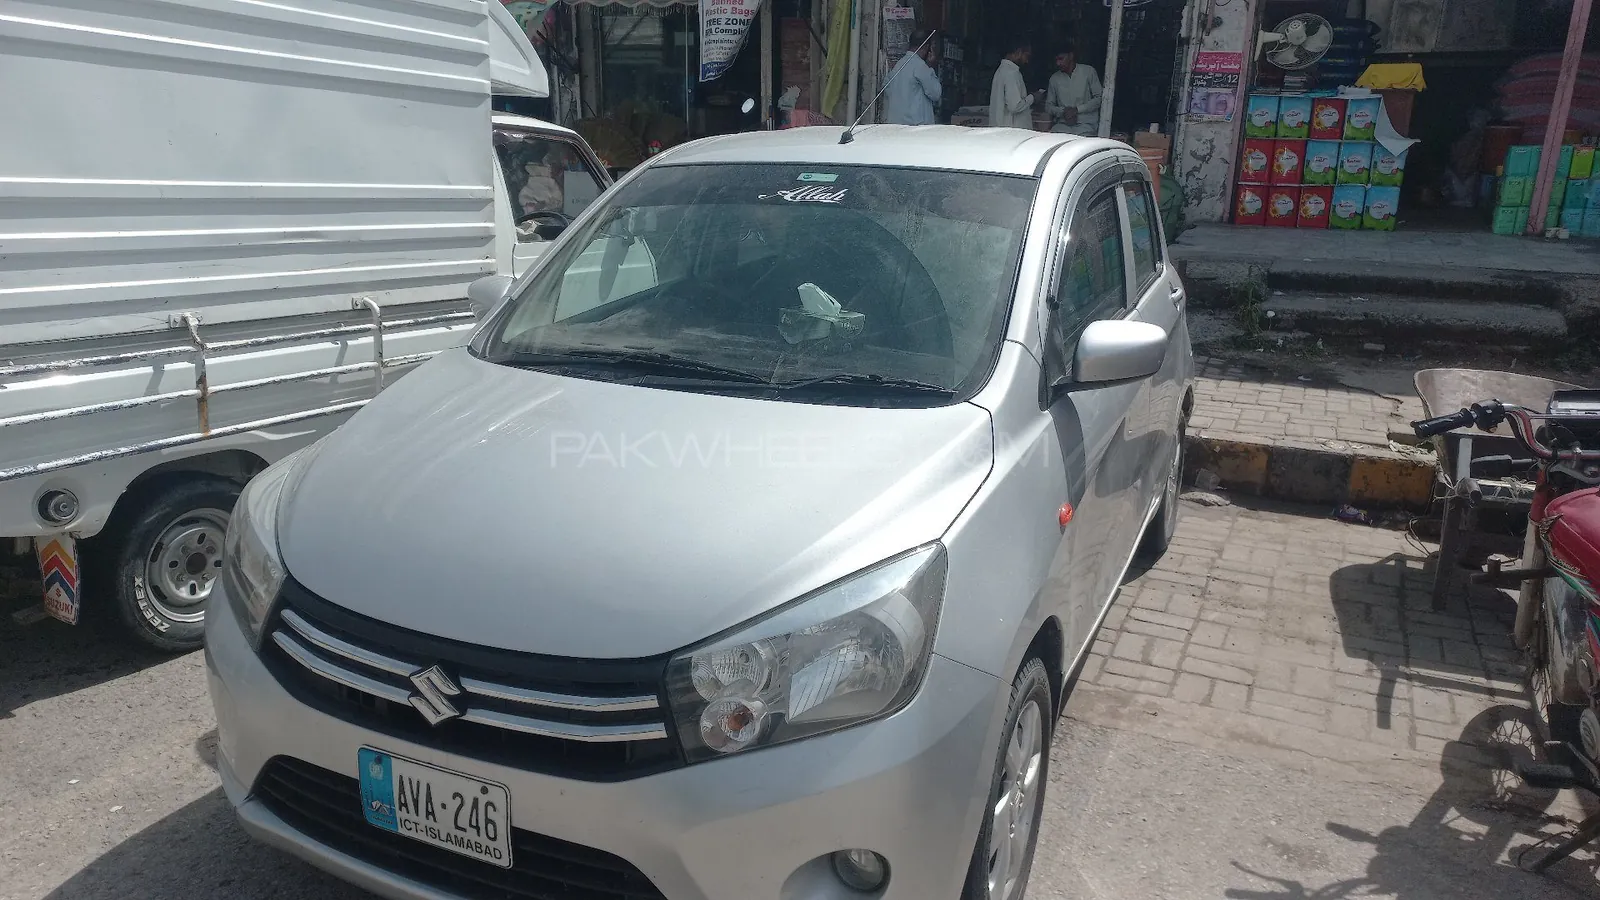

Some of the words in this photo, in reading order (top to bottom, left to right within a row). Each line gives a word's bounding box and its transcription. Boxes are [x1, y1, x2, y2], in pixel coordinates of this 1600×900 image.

[730, 7, 755, 17] Bags
[706, 18, 722, 28] FREE
[1227, 74, 1239, 83] 12
[758, 185, 849, 204] Allah
[46, 596, 74, 616] SUZUKI
[134, 575, 171, 633] ZEETEX
[400, 818, 502, 860] ICT-ISLAMABAD
